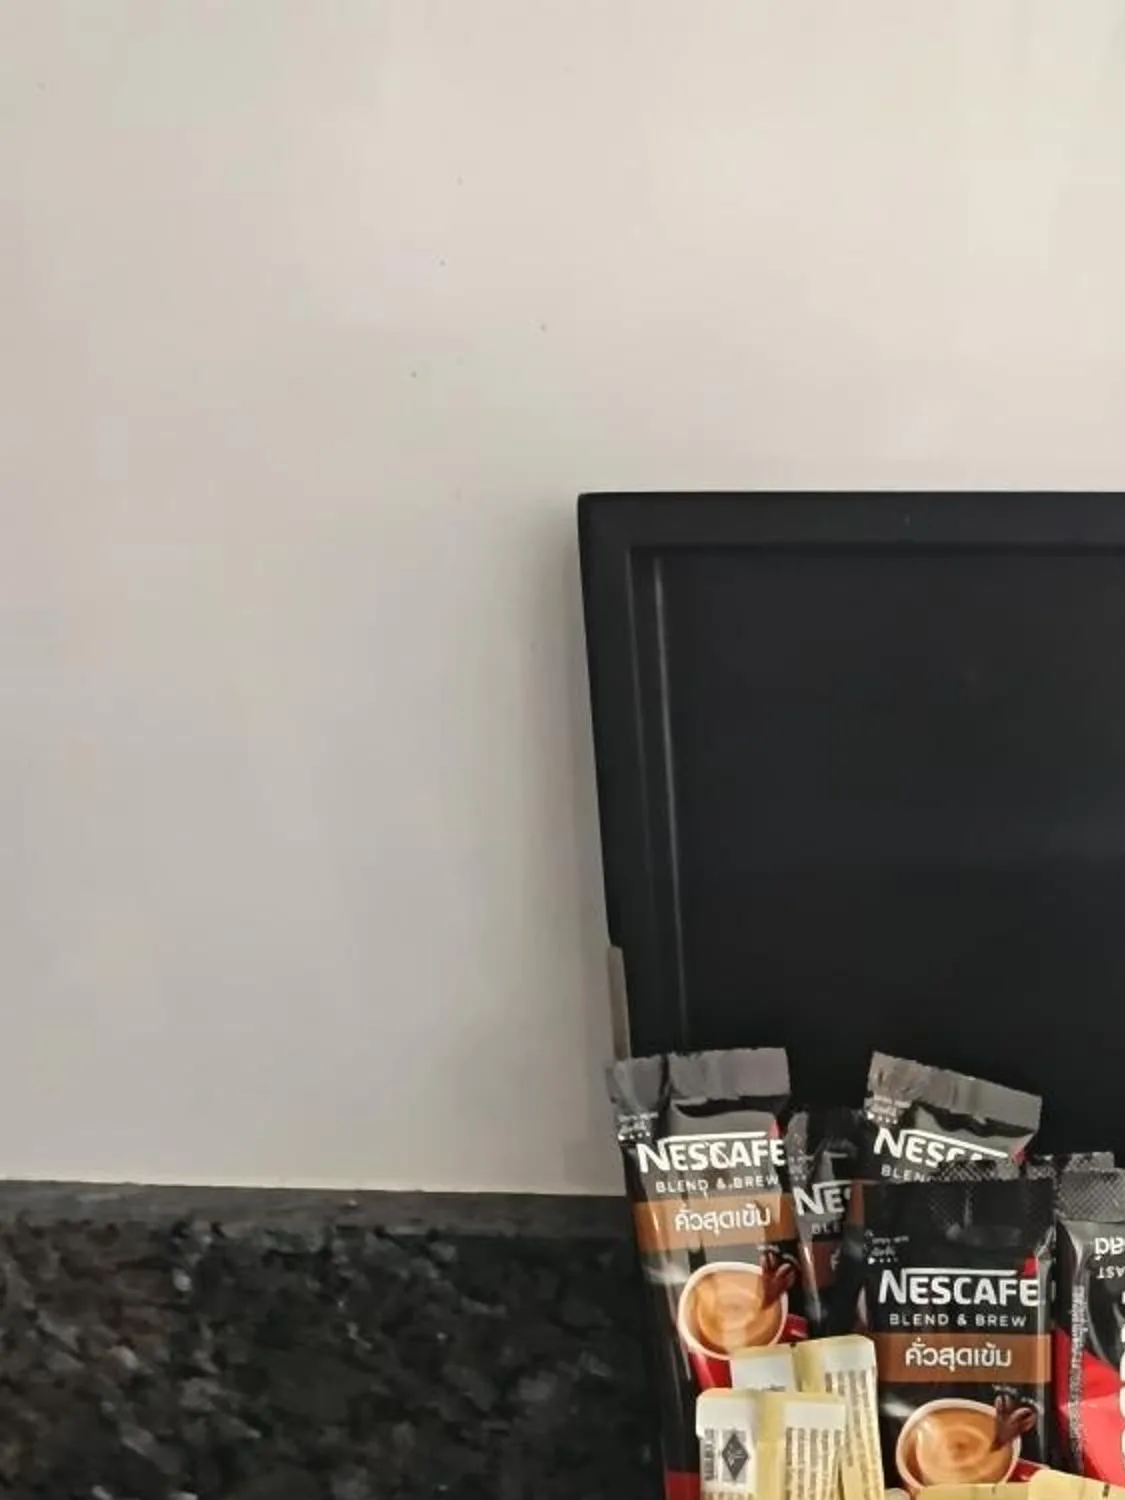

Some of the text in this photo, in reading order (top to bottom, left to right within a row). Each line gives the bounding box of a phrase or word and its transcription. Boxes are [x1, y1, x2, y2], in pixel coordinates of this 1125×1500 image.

[655, 1174, 779, 1194] BLEND & BREW
[674, 1203, 771, 1236] คั่วสุดเข้ม
[889, 1313, 1026, 1327] BLEND & BREW
[905, 1336, 1012, 1372] คั่วสุดเข้ม
